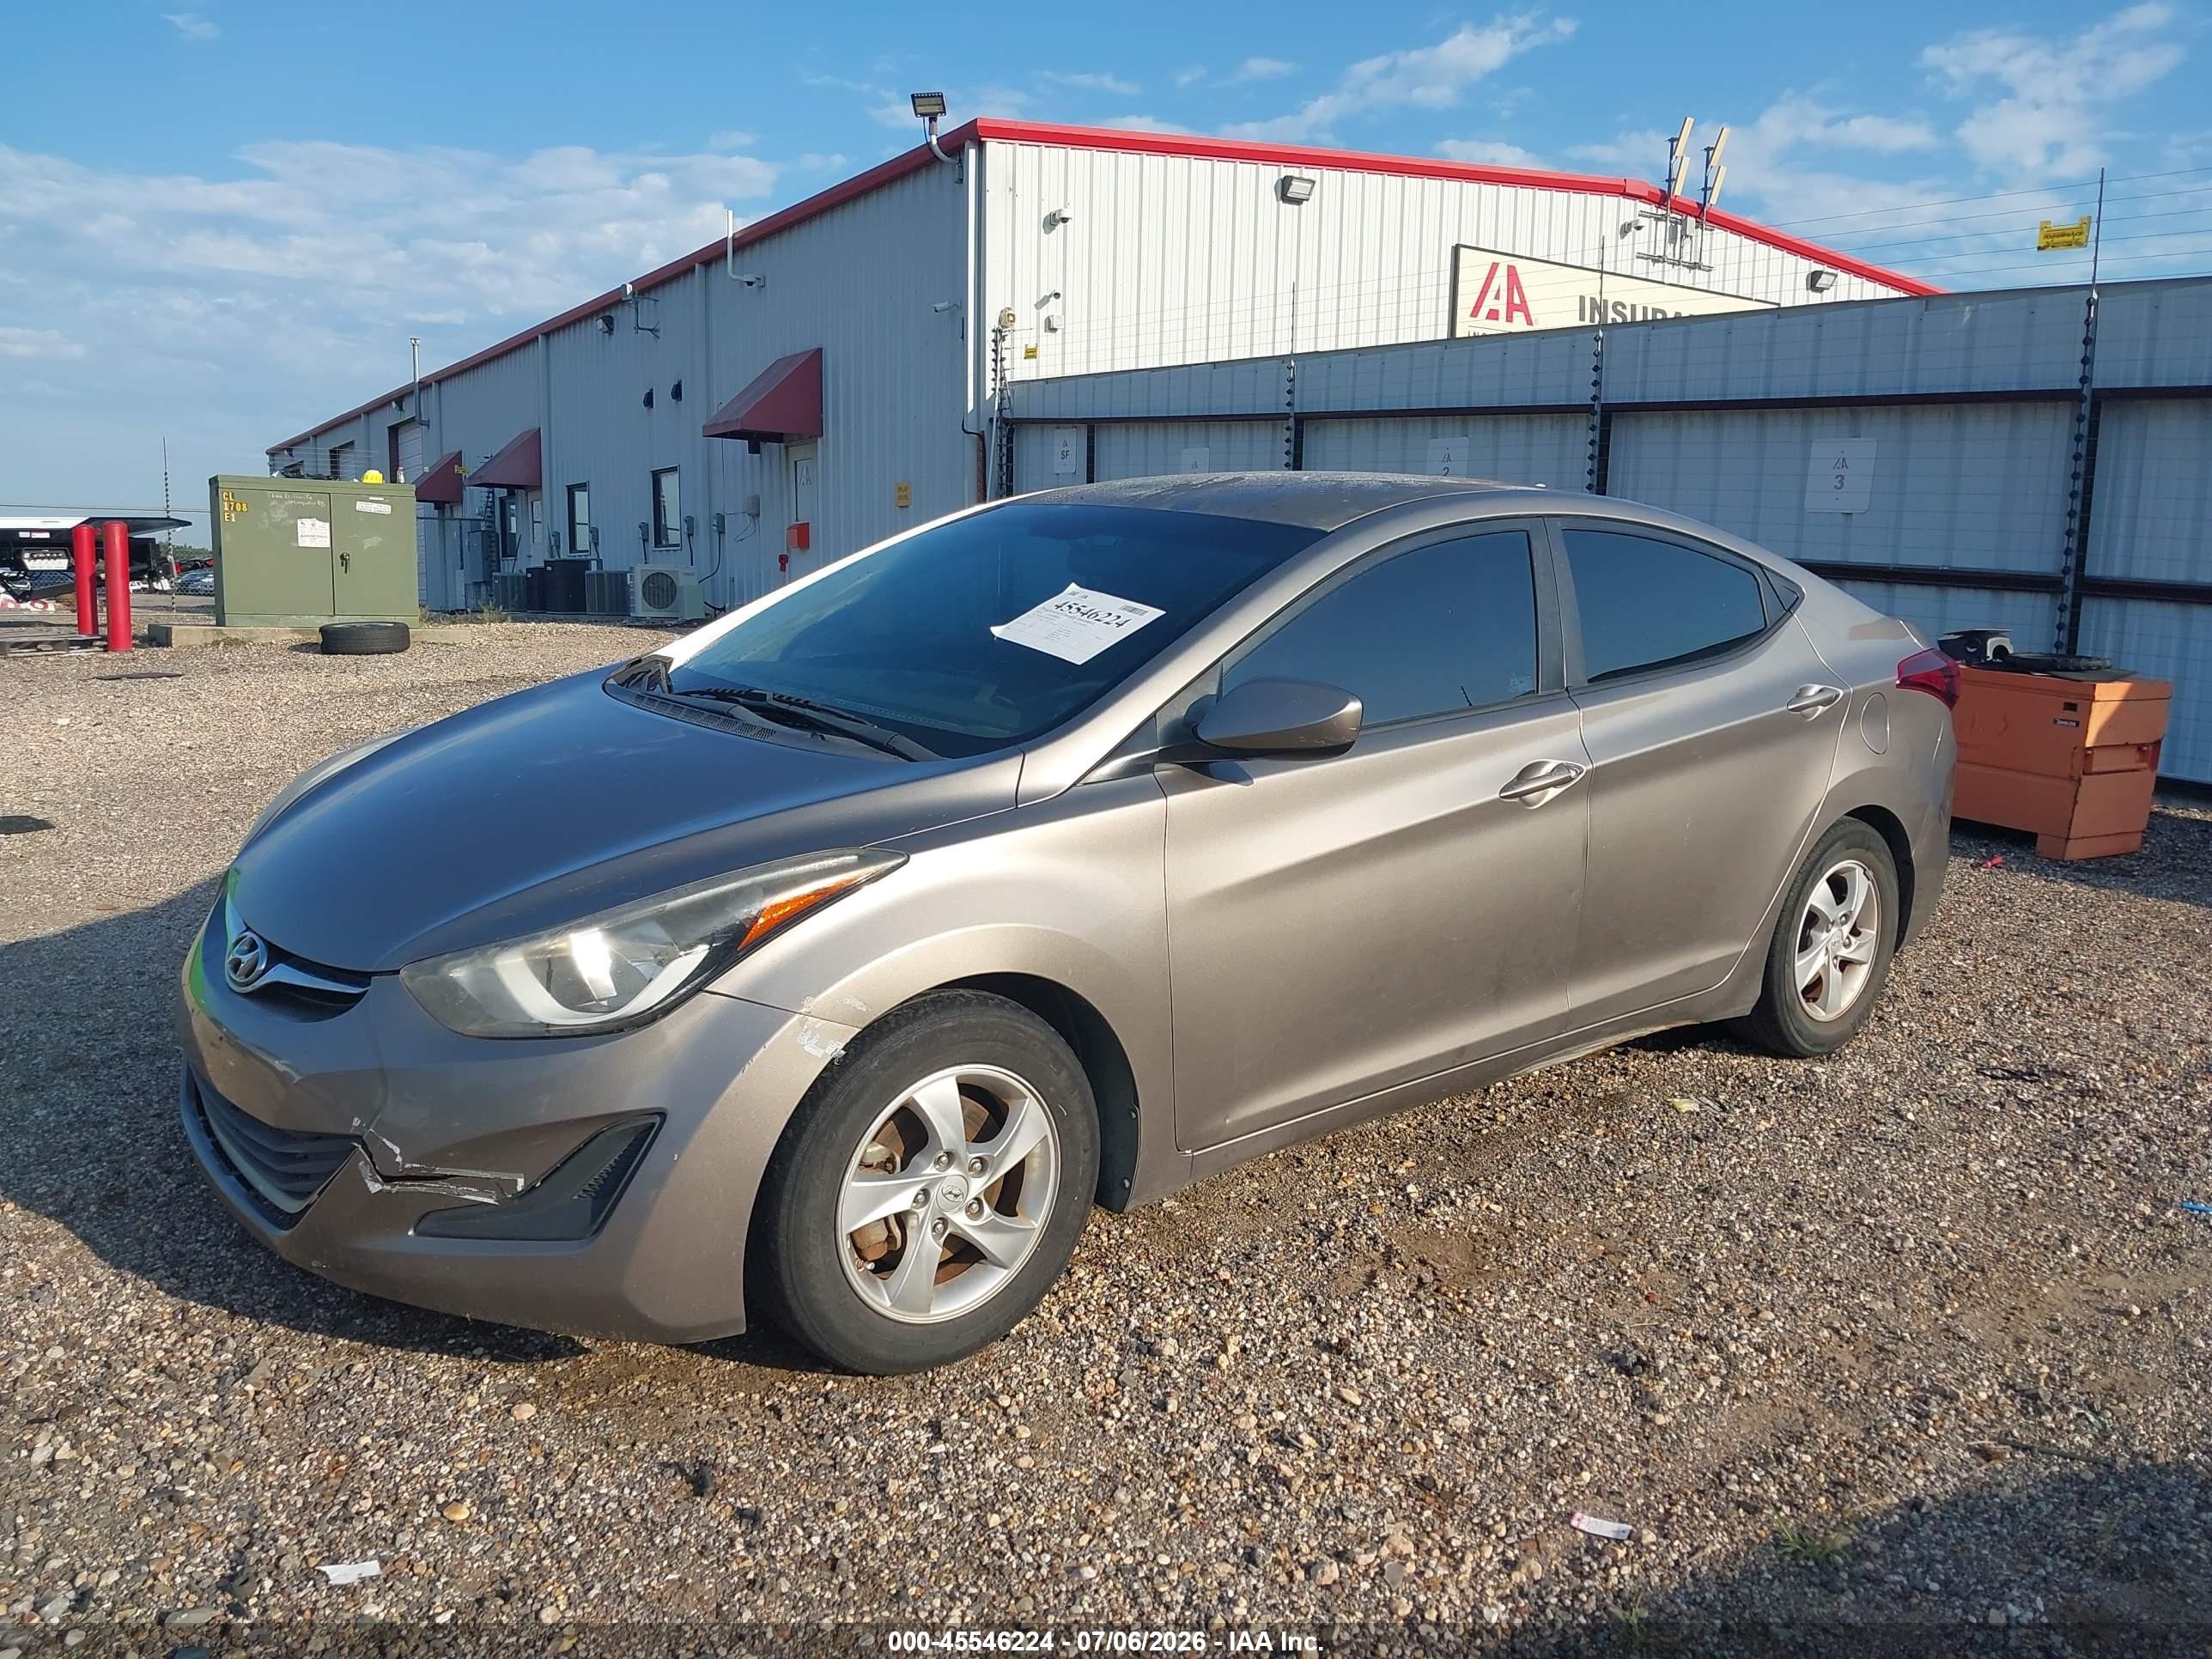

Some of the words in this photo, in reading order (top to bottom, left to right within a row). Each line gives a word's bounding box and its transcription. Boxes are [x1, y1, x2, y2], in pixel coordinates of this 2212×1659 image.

[1060, 450, 1070, 460] SF
[1443, 466, 1450, 477] 2
[1833, 474, 1845, 491] 3
[222, 491, 234, 501] CL
[224, 501, 247, 512] 1708
[224, 512, 236, 522] E1
[1054, 601, 1133, 629] 45546224
